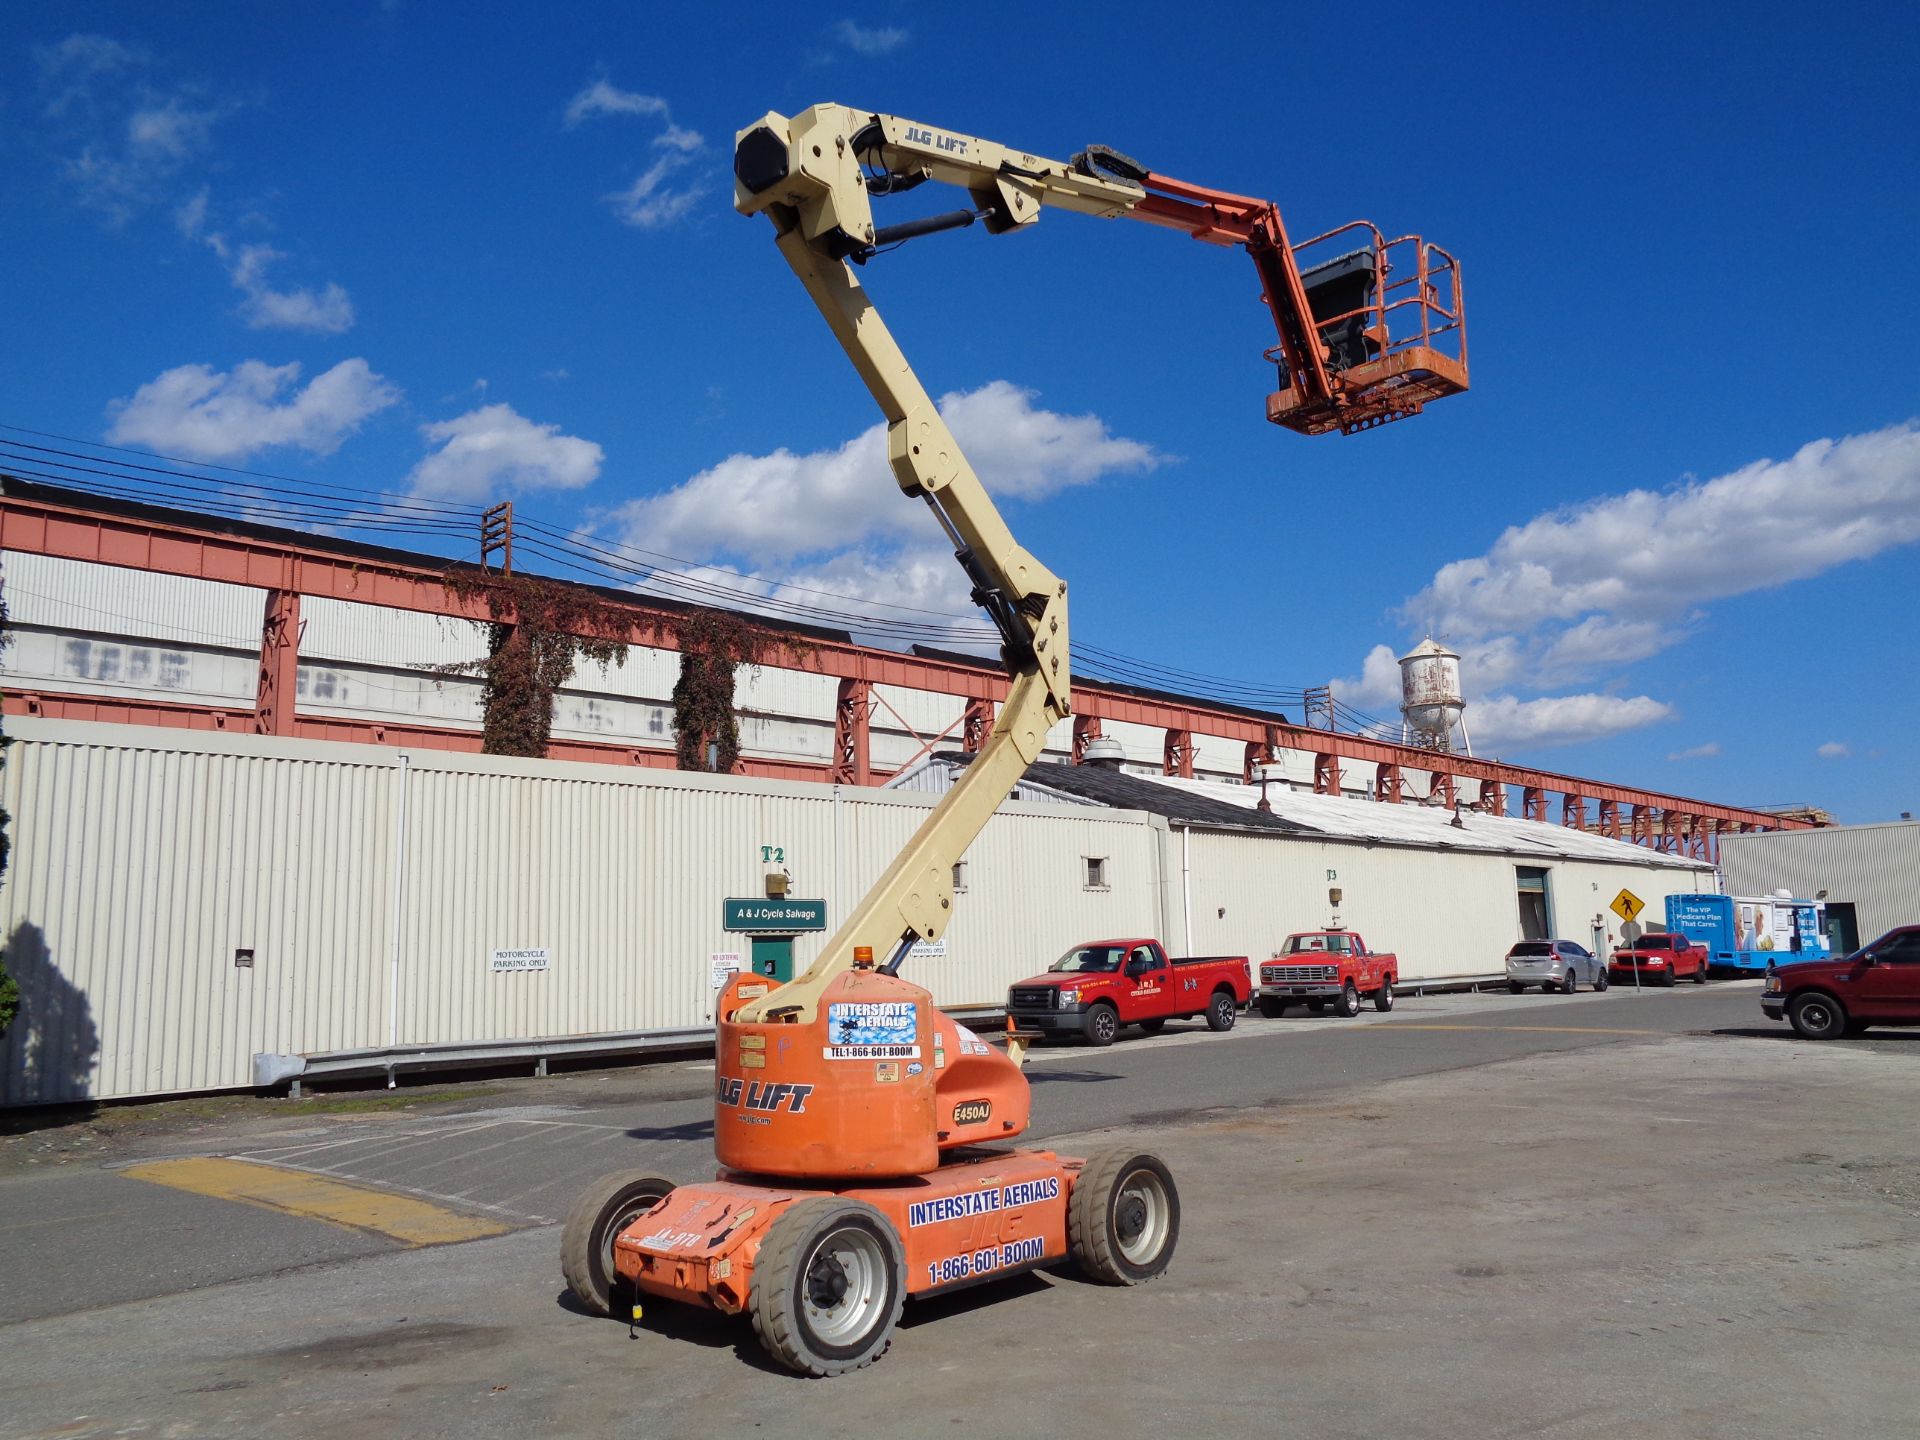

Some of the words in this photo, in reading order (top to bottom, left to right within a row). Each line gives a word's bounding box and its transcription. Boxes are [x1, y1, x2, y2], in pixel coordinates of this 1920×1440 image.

[905, 127, 932, 146] JLG
[936, 135, 968, 154] LIFT
[761, 846, 785, 863] T2
[1326, 869, 1337, 881] T3
[737, 909, 744, 918] A
[746, 909, 752, 918] &
[754, 909, 759, 918] J
[761, 909, 784, 920] Cycle
[786, 909, 816, 921] Salvage
[836, 1003, 909, 1017] INTERSTATE
[858, 1016, 908, 1028] AERIALS
[831, 1047, 913, 1057] TEL:1-866-601-BOOM
[744, 1081, 814, 1113] LIFT
[954, 1105, 990, 1121] E450AJ
[910, 1189, 999, 1226] INTERSTATE
[1003, 1178, 1058, 1208] AERIALS
[959, 1208, 1024, 1254] JLG
[928, 1237, 1044, 1284] 1-866-601-BOOM
